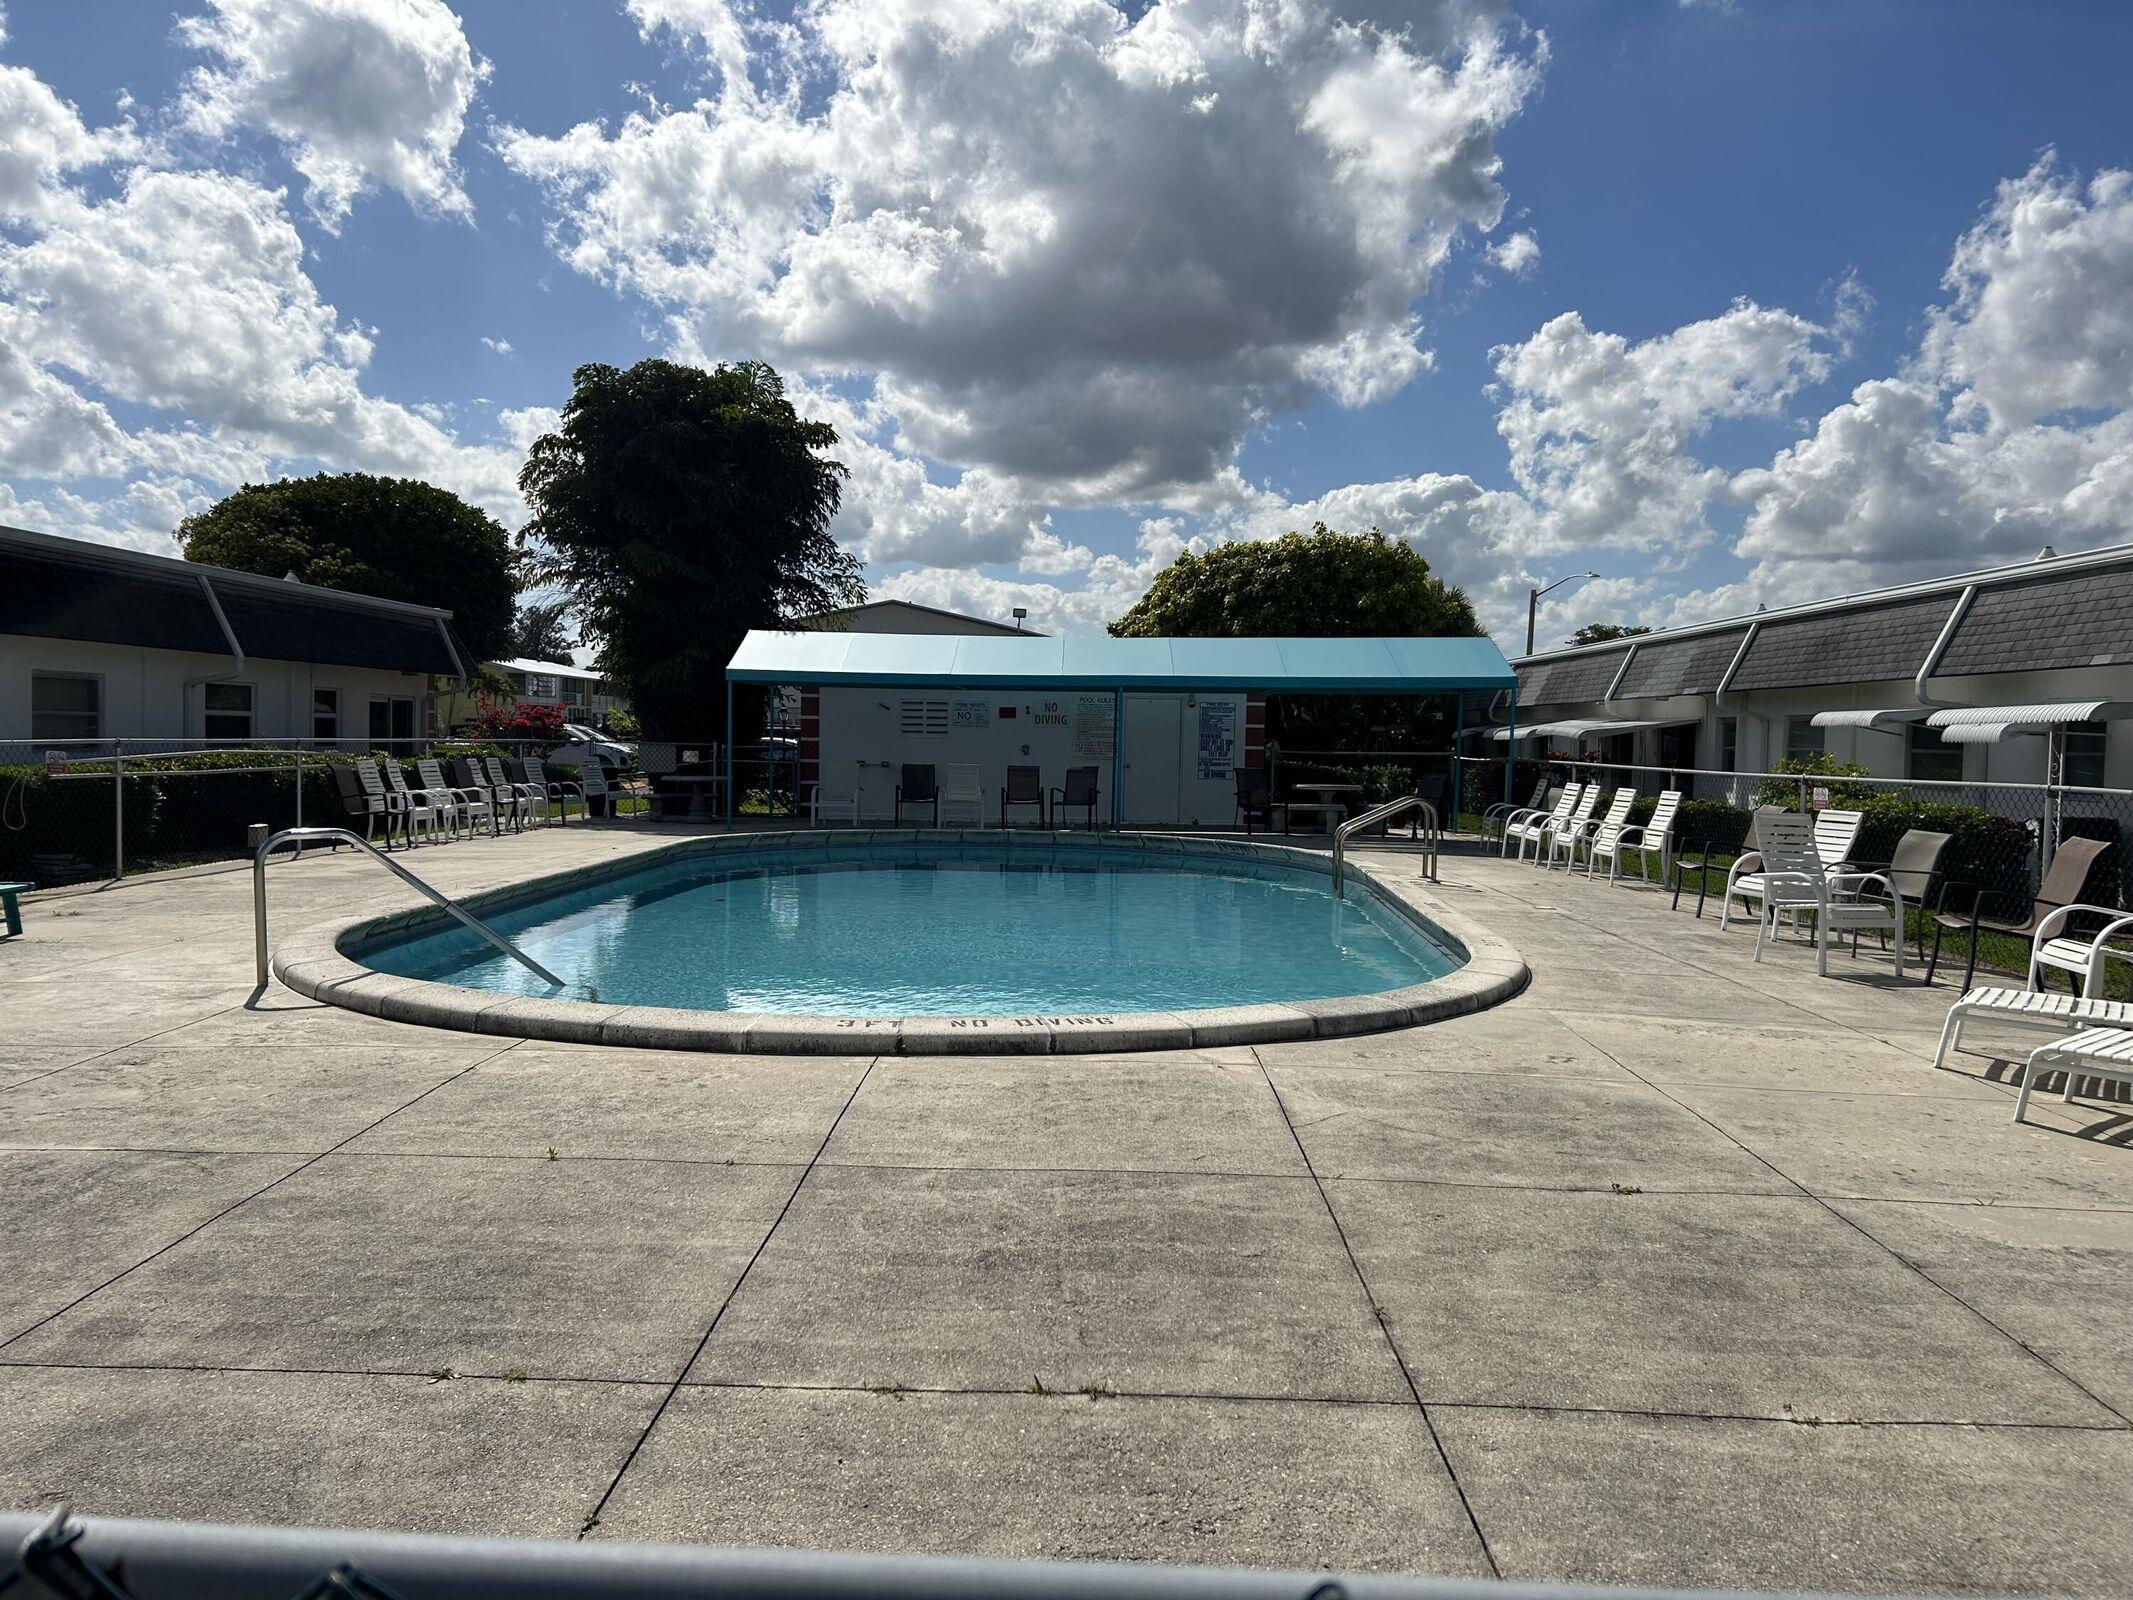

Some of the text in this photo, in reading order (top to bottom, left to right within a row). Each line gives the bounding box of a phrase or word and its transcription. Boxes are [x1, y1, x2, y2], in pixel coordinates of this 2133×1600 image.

[1044, 702, 1058, 712] NO
[957, 711, 971, 720] NO
[1034, 714, 1068, 725] DIVING
[951, 1019, 988, 1028] NO
[1015, 1016, 1114, 1027] DIVING
